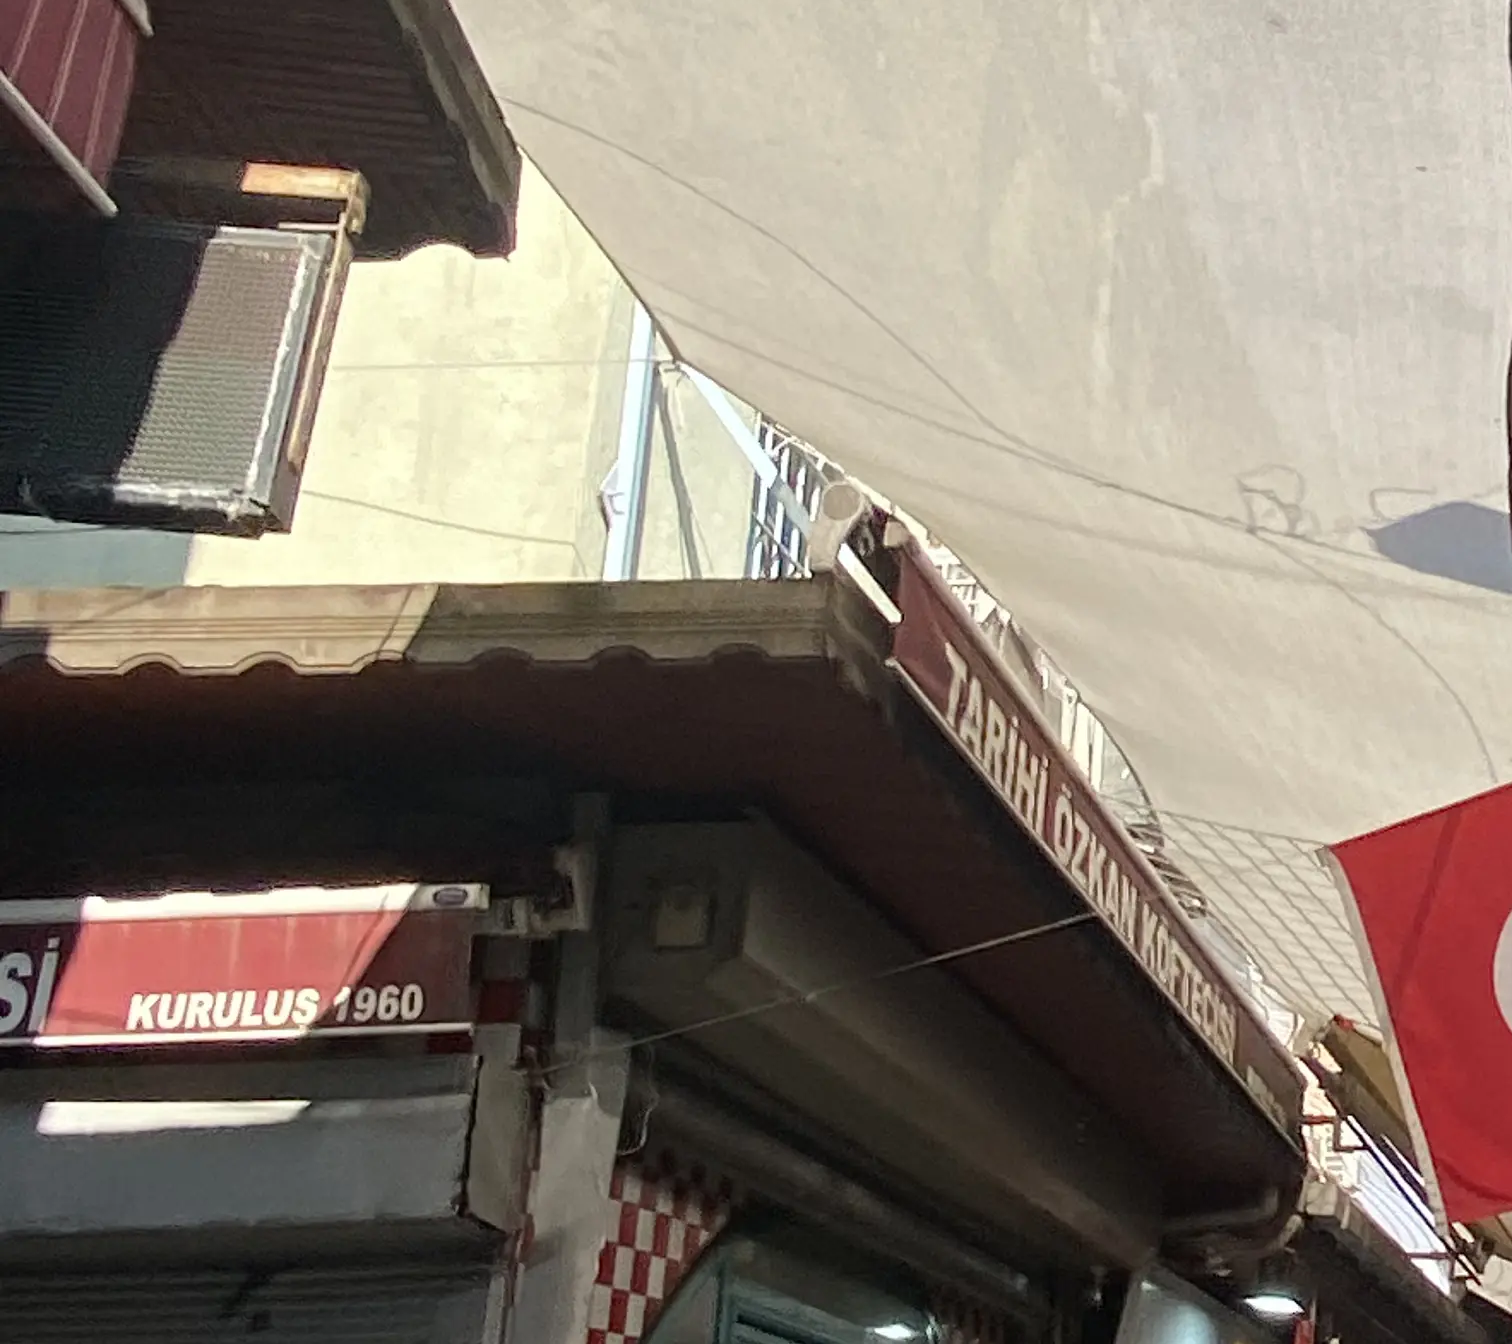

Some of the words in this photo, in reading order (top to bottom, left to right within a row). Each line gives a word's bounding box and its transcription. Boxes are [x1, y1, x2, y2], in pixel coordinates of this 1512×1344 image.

[944, 642, 1049, 833] TARİHİ
[1053, 783, 1139, 945] ÖZKAN
[333, 984, 424, 1022] 1960
